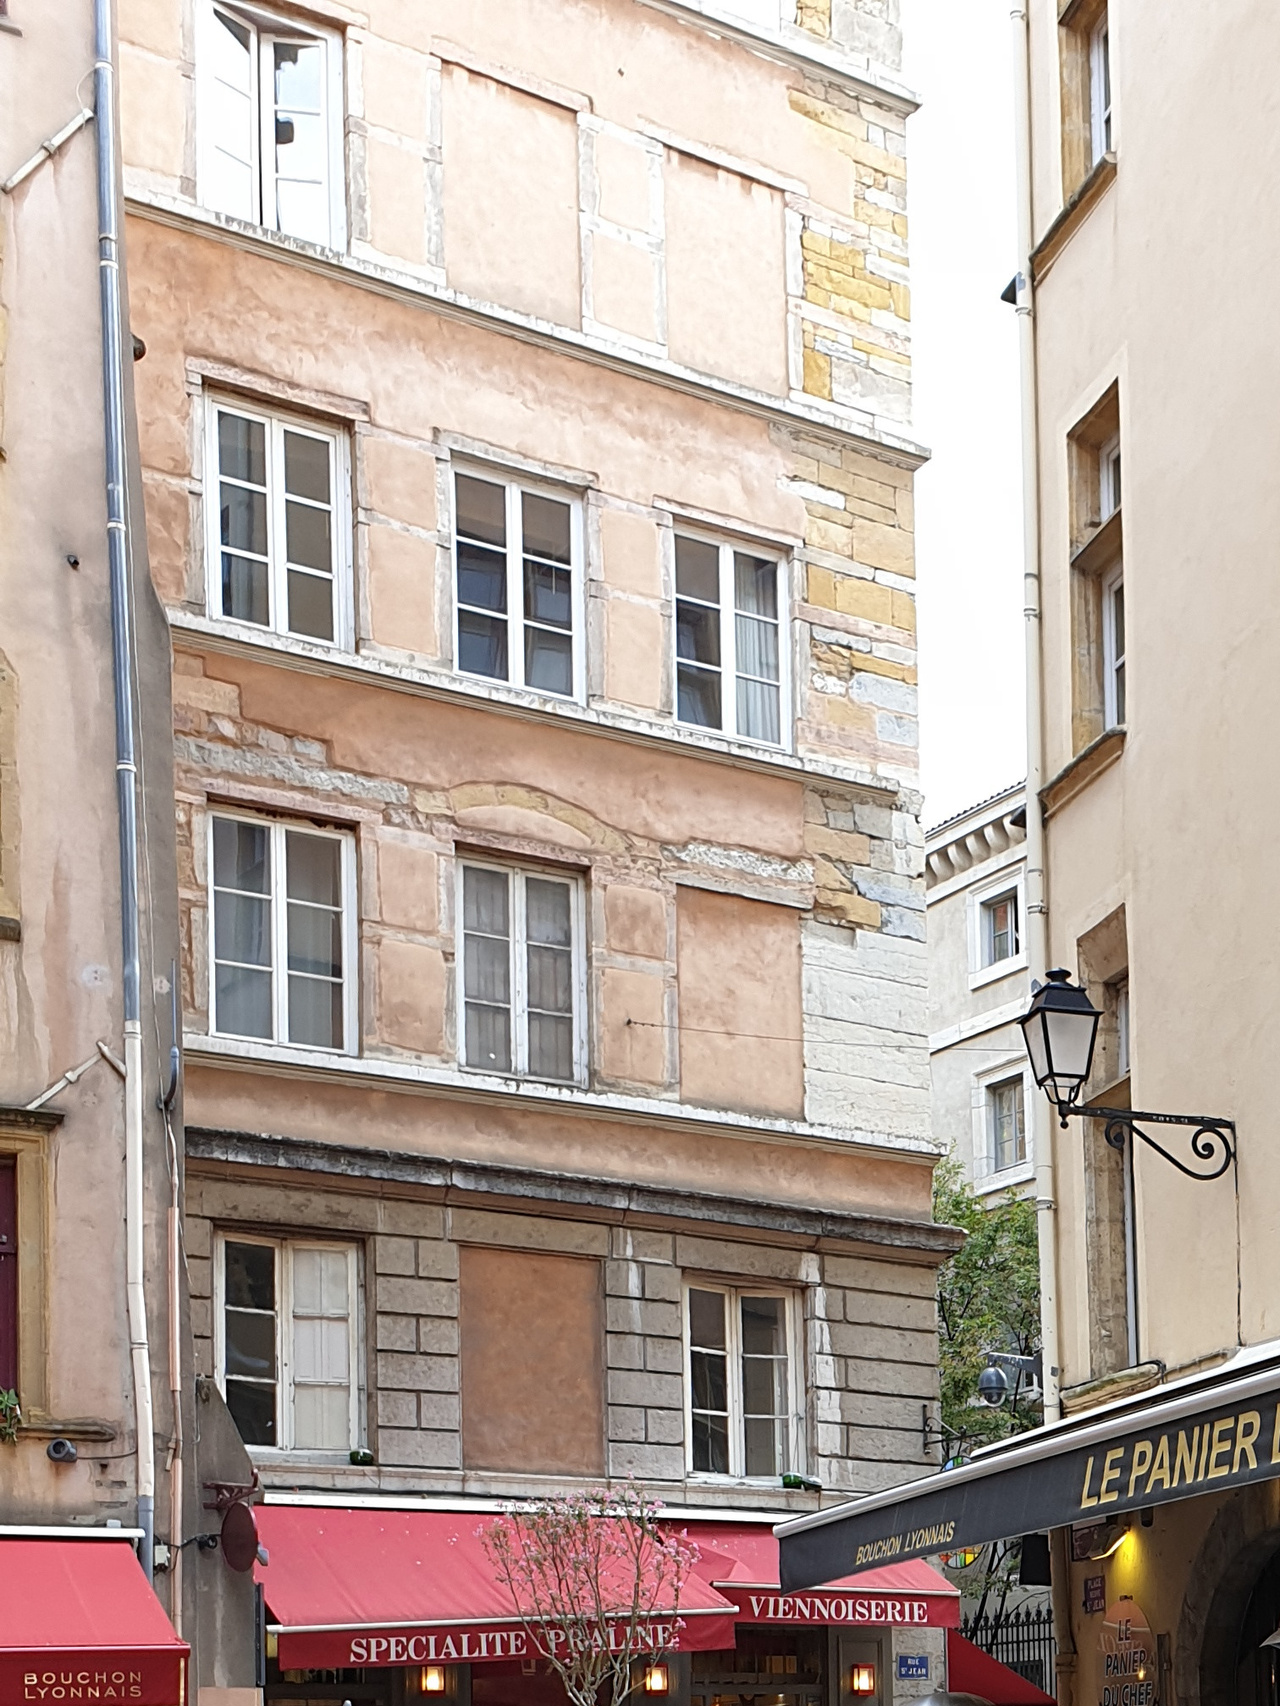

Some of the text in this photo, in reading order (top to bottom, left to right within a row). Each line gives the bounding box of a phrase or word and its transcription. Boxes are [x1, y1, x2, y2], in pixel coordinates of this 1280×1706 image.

[1080, 1446, 1125, 1509] LE
[1127, 1410, 1261, 1498] PANIER
[855, 1521, 955, 1566] BOUCHON LYONNAIS
[748, 1595, 928, 1623] VIENNOISERIE
[350, 1624, 674, 1663] SPECIALITE PRALINE
[1117, 1618, 1132, 1643] LE
[1105, 1649, 1148, 1678] PANIER
[24, 1671, 142, 1685] BOUCHON
[24, 1685, 142, 1699] LYONNAIS
